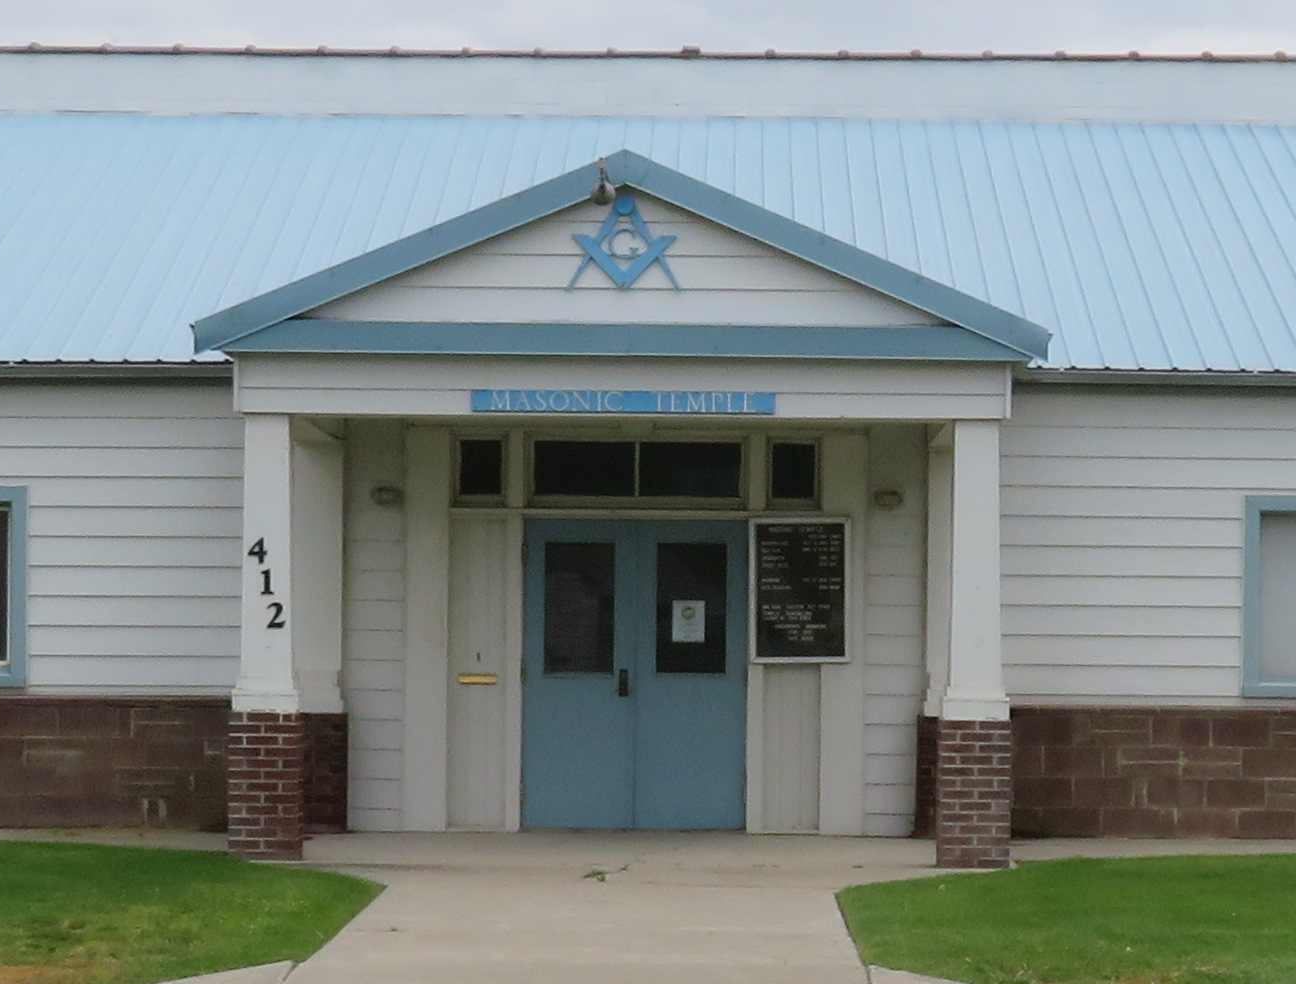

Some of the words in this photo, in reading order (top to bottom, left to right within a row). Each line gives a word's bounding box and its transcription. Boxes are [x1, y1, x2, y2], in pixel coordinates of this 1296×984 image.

[608, 228, 639, 260] G
[490, 390, 624, 413] MASONIC
[655, 392, 756, 414] TEMPLE
[247, 536, 286, 630] 412
